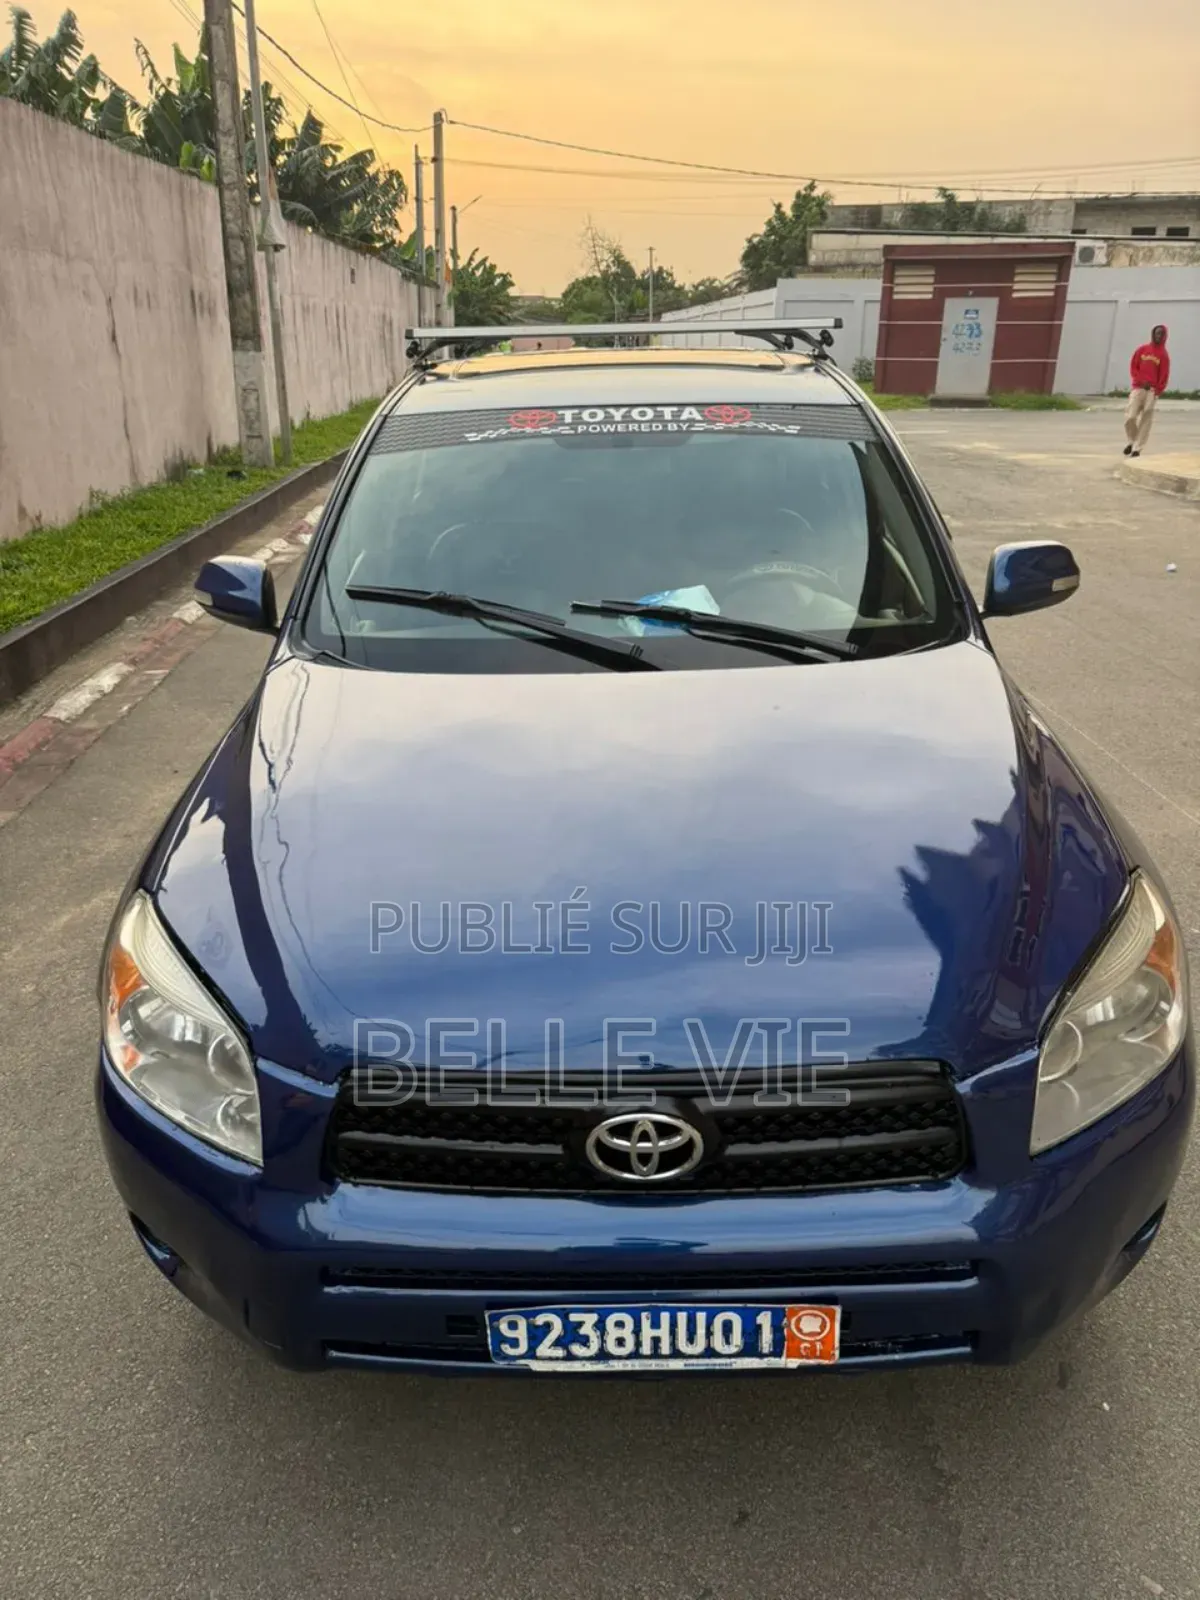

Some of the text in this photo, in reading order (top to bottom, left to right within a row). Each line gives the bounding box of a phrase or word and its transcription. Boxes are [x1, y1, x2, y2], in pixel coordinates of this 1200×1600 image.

[557, 407, 703, 424] TOYOTA
[577, 422, 690, 433] POWERED BY
